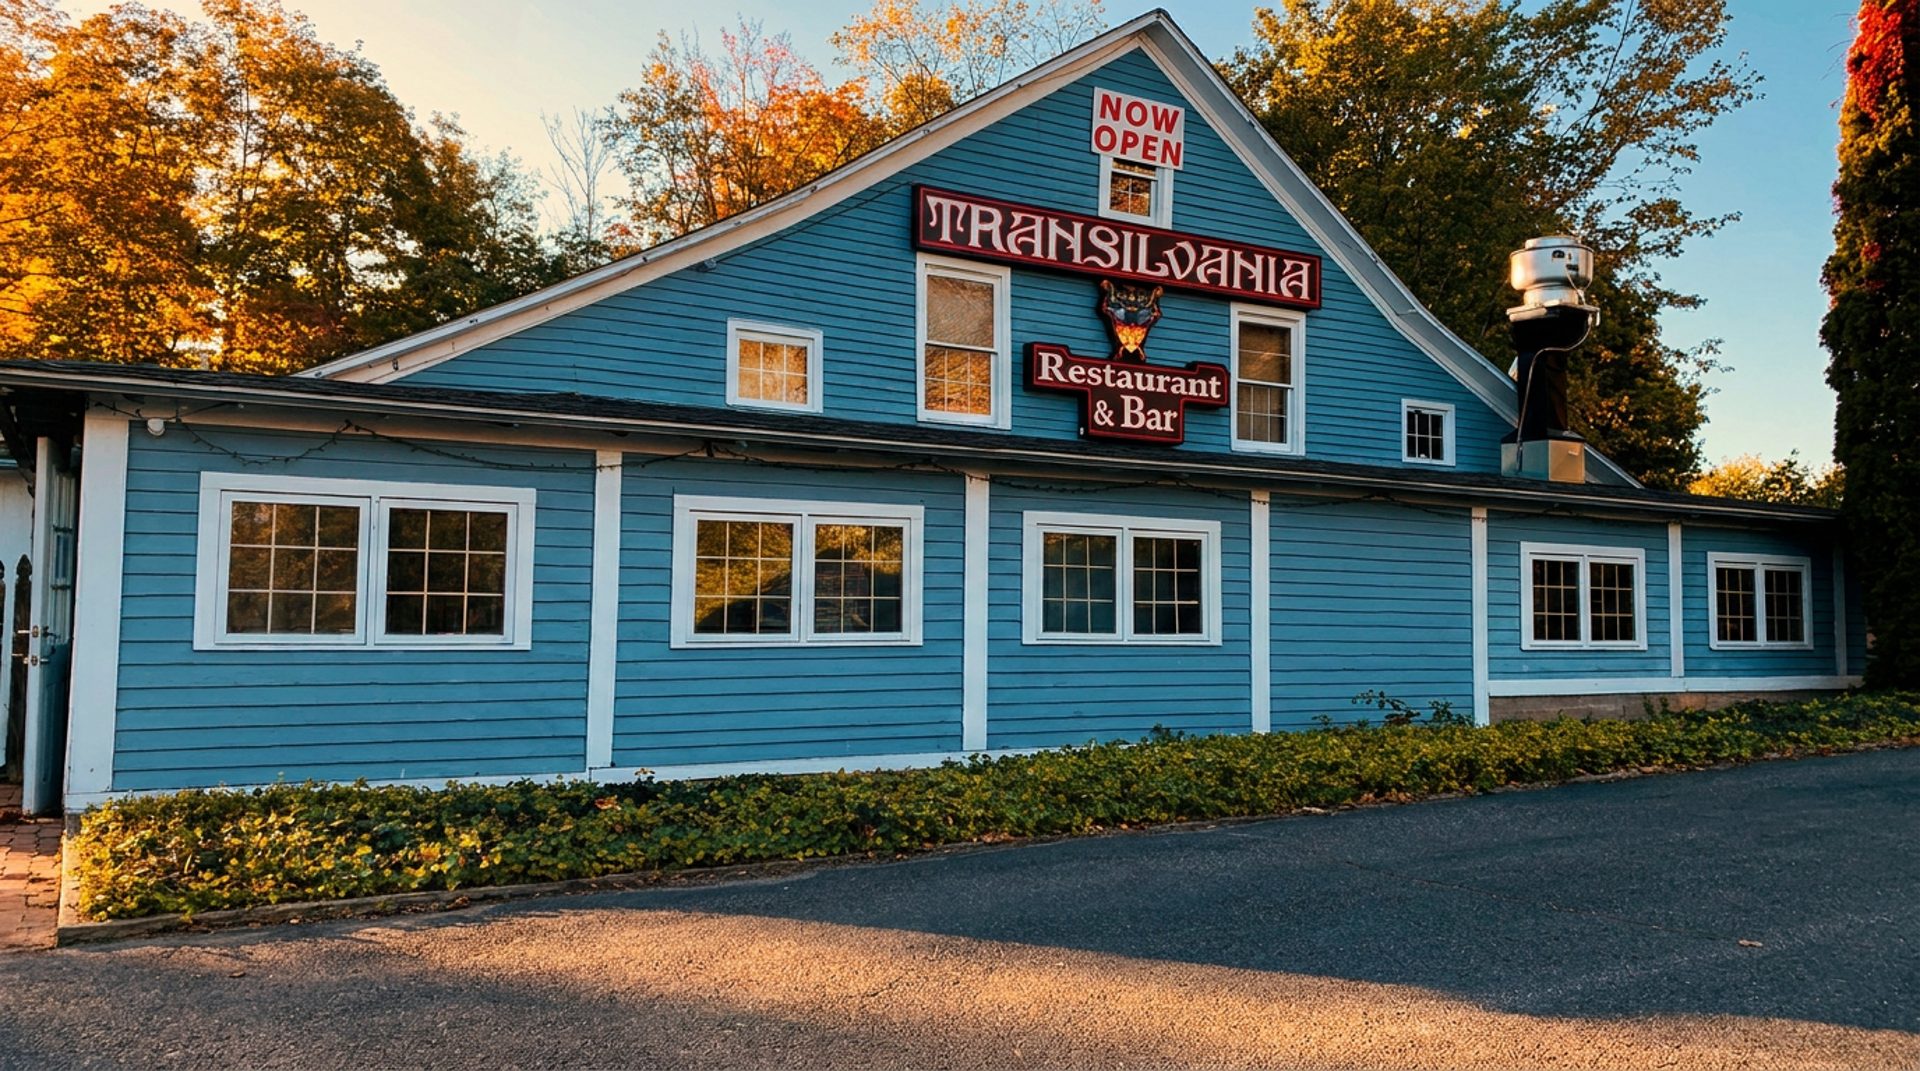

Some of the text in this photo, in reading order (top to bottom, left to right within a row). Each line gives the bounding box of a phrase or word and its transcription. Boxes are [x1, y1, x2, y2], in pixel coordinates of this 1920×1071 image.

[1099, 94, 1180, 134] NOW
[1094, 125, 1182, 167] OPEN
[925, 195, 1310, 300] TRANSILVANIA
[1037, 352, 1222, 399] Restaurant
[1093, 396, 1178, 432] & Bar
